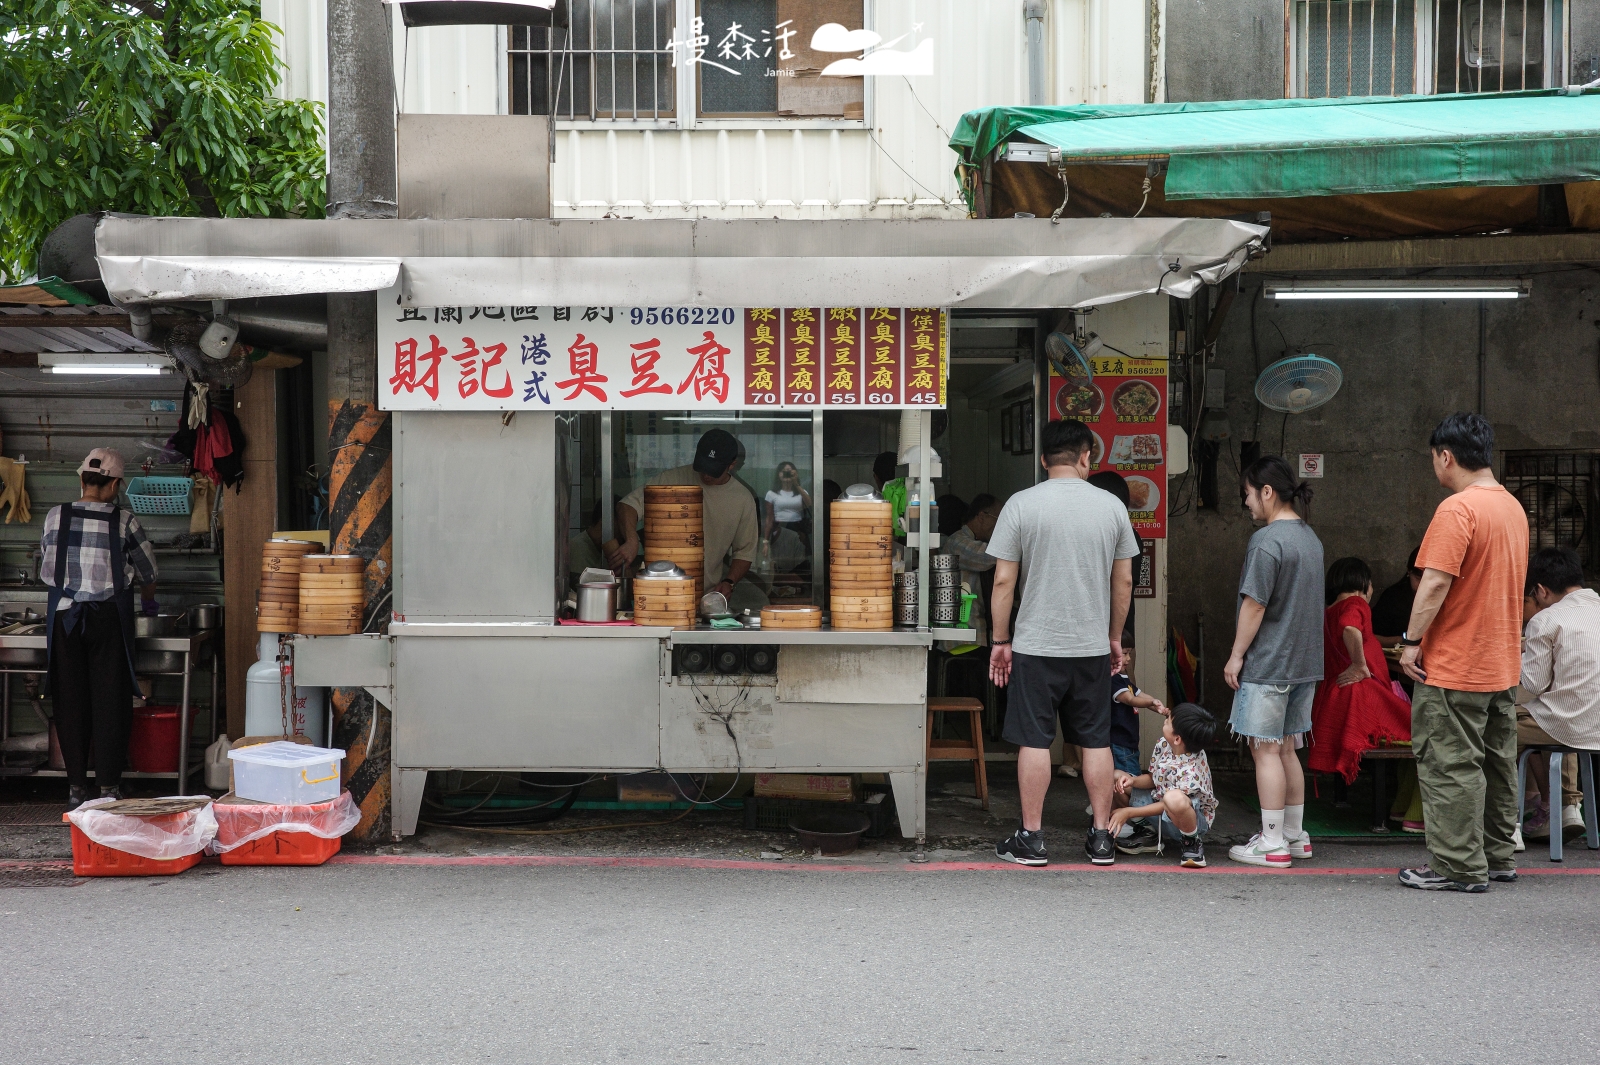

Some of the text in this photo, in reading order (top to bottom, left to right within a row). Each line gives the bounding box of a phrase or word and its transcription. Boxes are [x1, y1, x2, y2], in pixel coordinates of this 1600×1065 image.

[630, 307, 735, 325] 9566220
[908, 308, 937, 389] 堡臭豆腐
[389, 334, 514, 401] 財記
[520, 333, 551, 405] 港式
[555, 331, 731, 404] 臭豆腐
[1127, 367, 1165, 375] 9566220
[751, 393, 776, 403] 70
[791, 393, 816, 403] 70
[831, 393, 856, 404] 55
[868, 393, 894, 403] 60
[910, 393, 936, 403] 45
